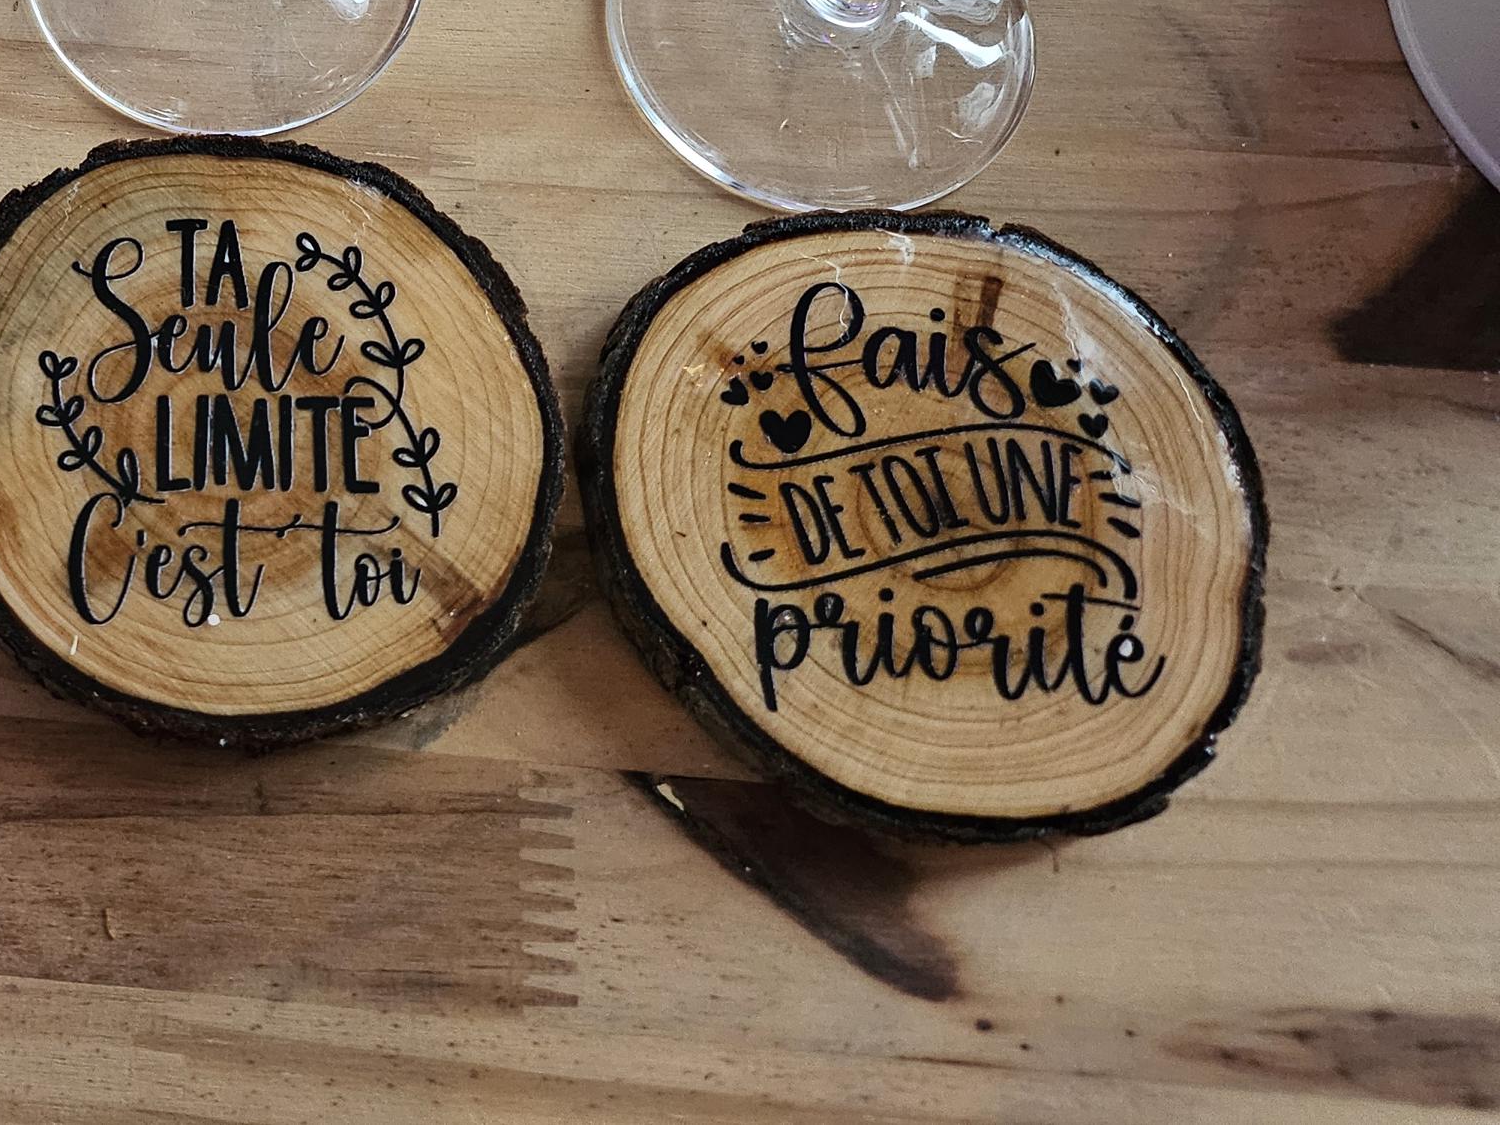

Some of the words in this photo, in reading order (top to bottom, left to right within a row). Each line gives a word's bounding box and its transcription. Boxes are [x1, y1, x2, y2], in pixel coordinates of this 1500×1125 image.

[72, 237, 344, 402] Seule
[166, 219, 250, 310] TA
[776, 281, 1035, 437] fais
[154, 394, 381, 494] LIMITE
[781, 475, 864, 566] DE
[852, 445, 967, 545] TOI
[964, 438, 1082, 529] UNE
[68, 492, 276, 627] C'est
[300, 501, 420, 620] toi
[754, 583, 1165, 712] priorité
